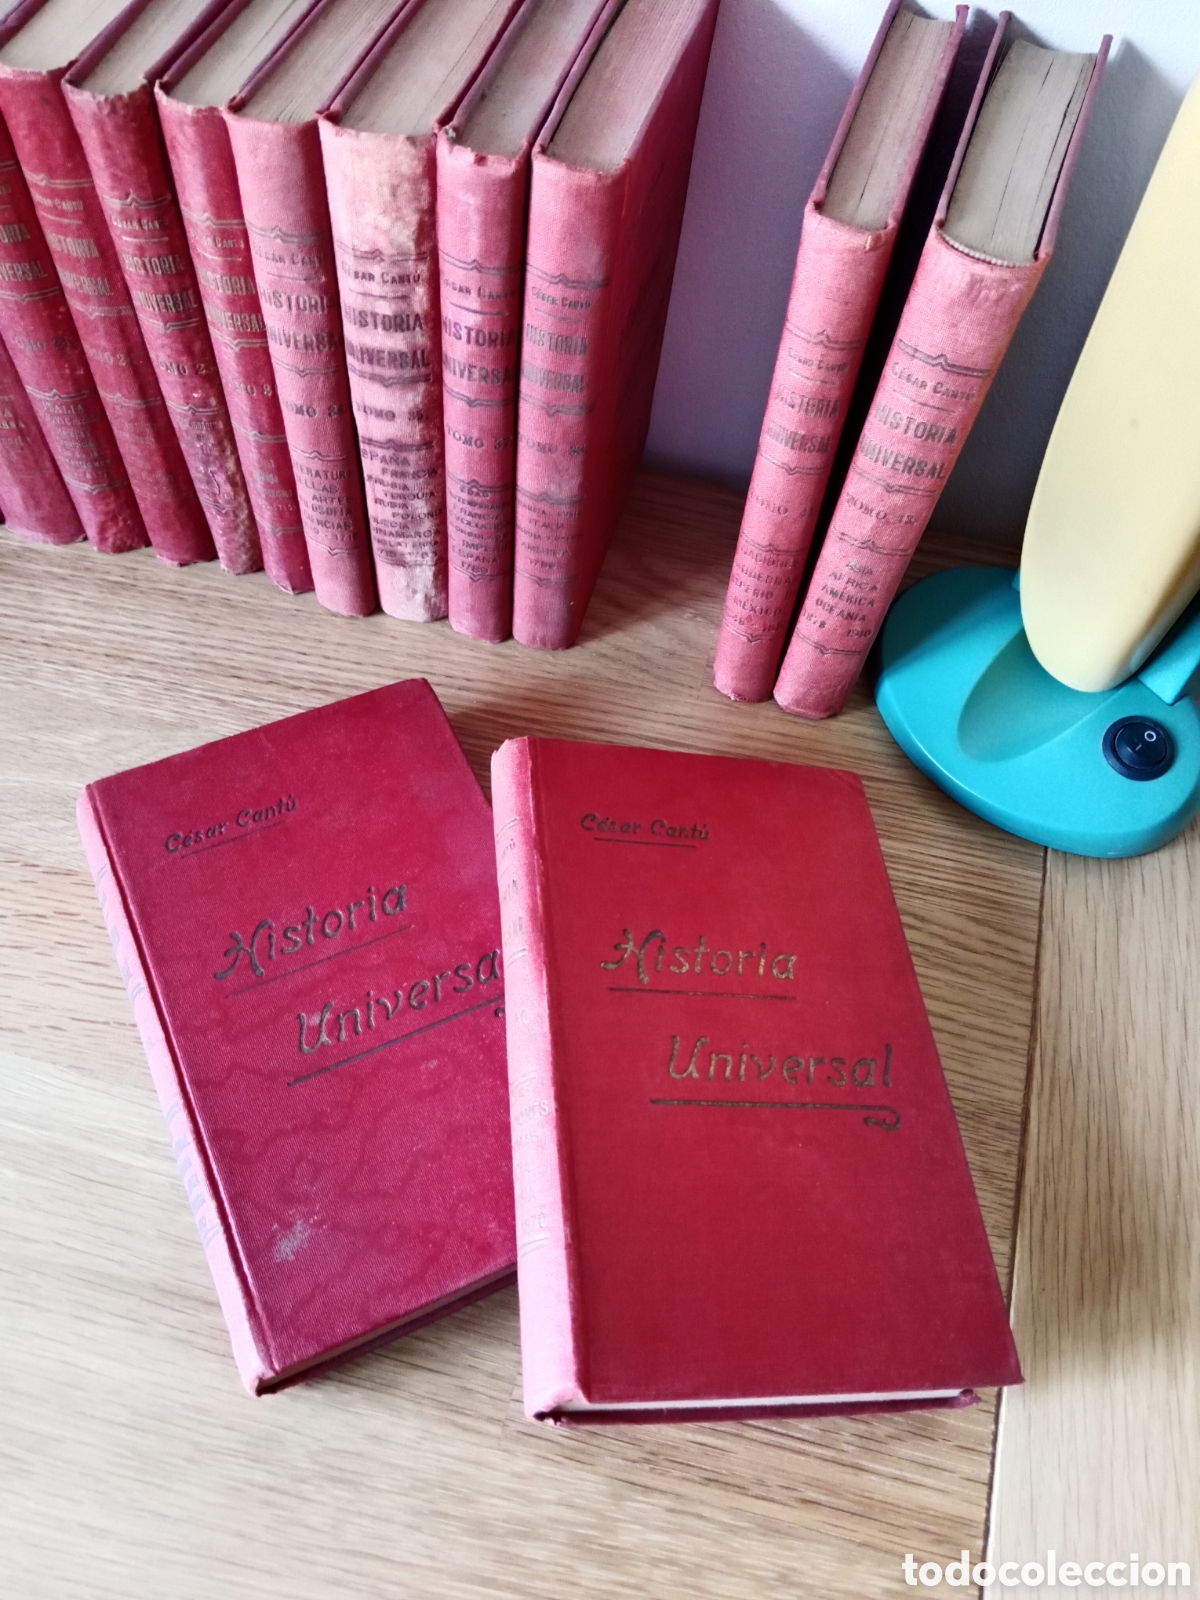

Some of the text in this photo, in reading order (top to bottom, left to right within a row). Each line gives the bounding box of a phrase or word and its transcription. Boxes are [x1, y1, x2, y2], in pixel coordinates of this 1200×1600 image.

[199, 266, 256, 296] STORIA
[259, 284, 329, 315] HISTORI
[343, 303, 424, 333] HISTORIA
[875, 403, 958, 446] HISTORIA
[860, 434, 947, 481] UNIVERSAL
[165, 794, 298, 854] César Cantú
[580, 812, 710, 842] César Cantú
[213, 883, 407, 981] Historia
[600, 928, 798, 985] Historia
[298, 948, 502, 1055] Universa
[667, 1034, 893, 1089] Universal
